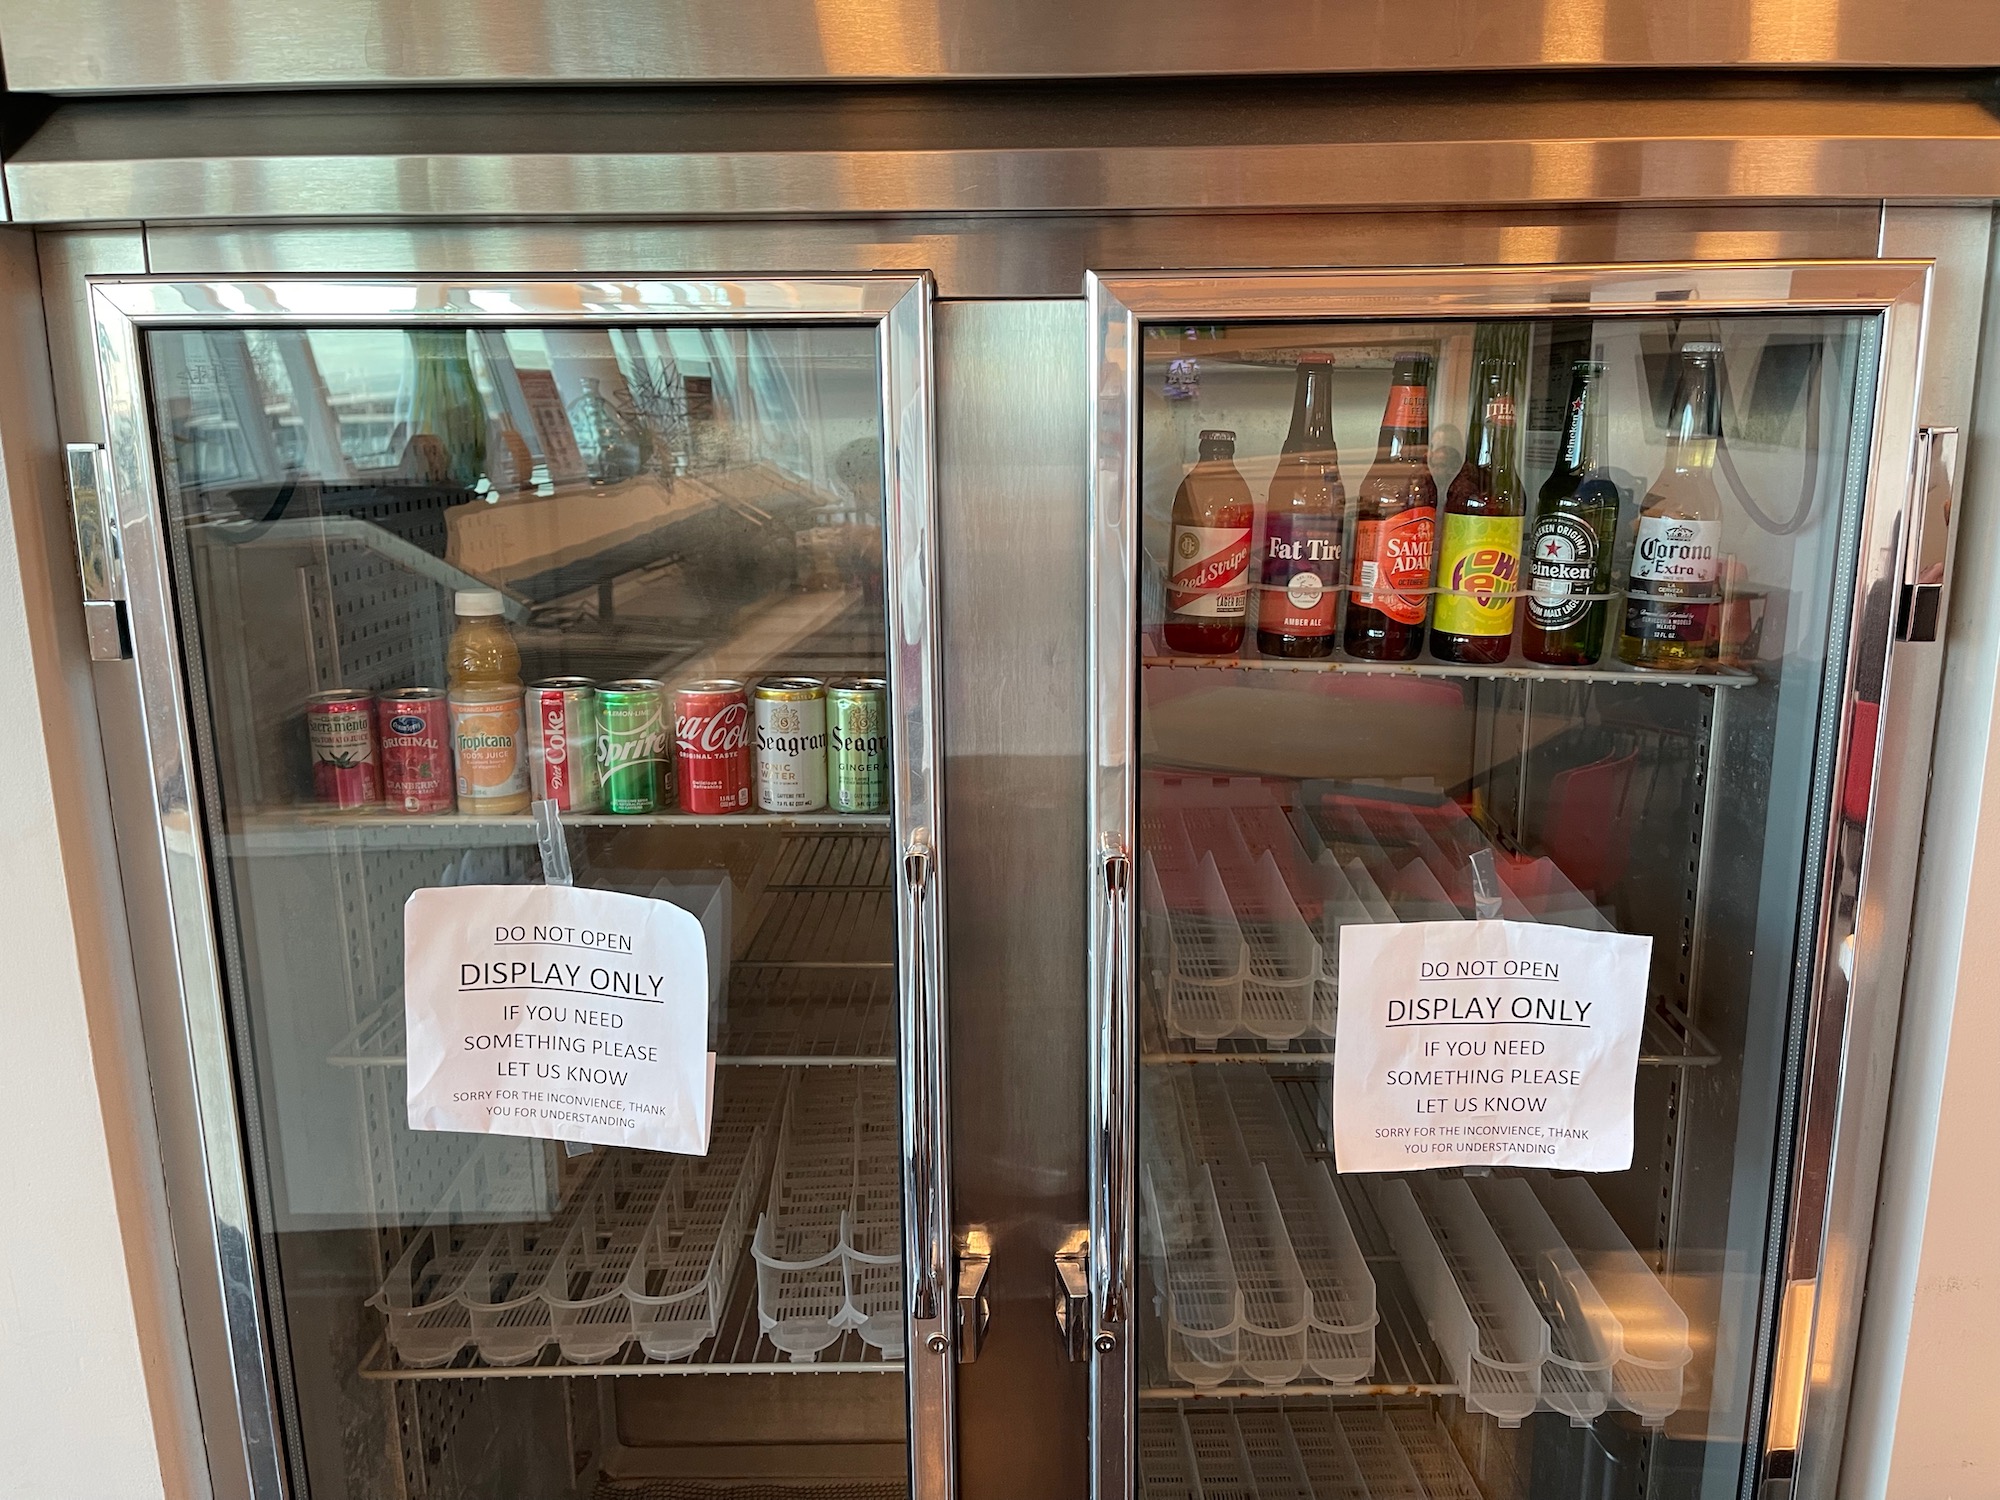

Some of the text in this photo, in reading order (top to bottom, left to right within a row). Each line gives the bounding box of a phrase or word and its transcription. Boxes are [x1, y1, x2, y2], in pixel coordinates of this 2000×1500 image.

[1565, 414, 1578, 462] Heineken
[1269, 537, 1303, 560] Fat
[1307, 540, 1342, 561] Tire
[1557, 525, 1588, 555] ORIGINAL
[1641, 537, 1712, 564] Corona
[1208, 547, 1247, 581] Stripe
[1655, 560, 1695, 575] Extra
[1284, 618, 1322, 627] AMBER ALE
[1543, 608, 1562, 618] MALT
[383, 738, 439, 749] ORIGINAL
[458, 732, 512, 752] Tropicana
[545, 711, 567, 790] Diet Coke
[597, 731, 666, 767] Sprite
[832, 726, 889, 757] Seagr
[485, 751, 509, 760] JUICE
[680, 751, 738, 760] ORIGINAL TASTE
[761, 762, 791, 772] TONIC
[839, 763, 880, 772] GINGER
[387, 781, 440, 791] CRANBERRY
[495, 926, 632, 951] DO NOT OPEN
[1421, 960, 1559, 978] DO NOT OPEN
[461, 962, 664, 997] DISPLAY ONLY
[504, 1005, 624, 1029] IF YOU NEED
[1388, 997, 1592, 1022] DISPLAY ONLY
[464, 1033, 658, 1062] SOMETHING PLEASE
[1425, 1040, 1545, 1057] IF YOU NEED
[498, 1062, 628, 1086] LET US KNOW
[1387, 1069, 1580, 1086] SOMETHING PLEASE
[453, 1090, 666, 1116] SORRY FOR THE INCONVIENCE, THANK
[1417, 1097, 1547, 1114] LET US KNOW
[486, 1107, 635, 1128] YOU FOR UNDERSTANDING
[1375, 1126, 1589, 1139] SORRY FOR THE INCONVIENCE, THANK
[1404, 1142, 1556, 1155] YOU FOR UNDERSTANDING
